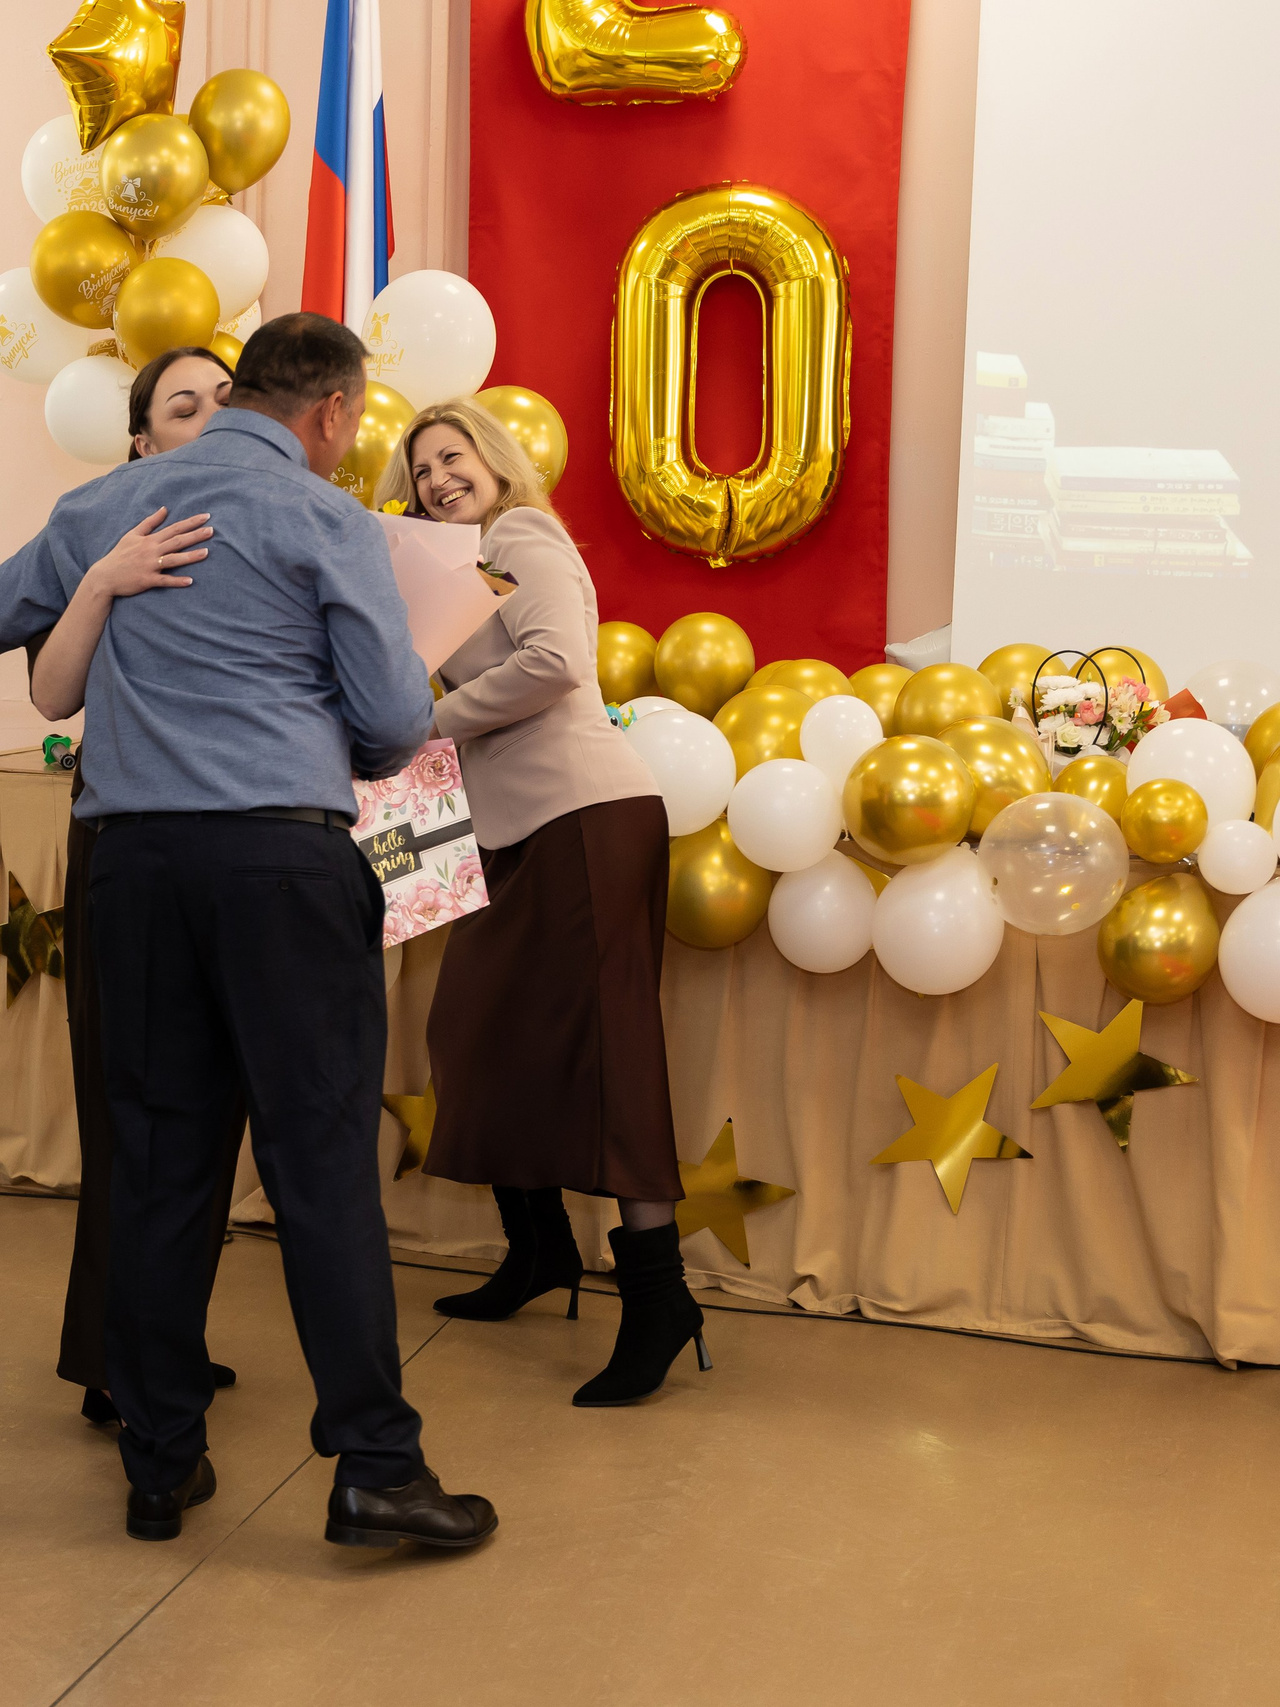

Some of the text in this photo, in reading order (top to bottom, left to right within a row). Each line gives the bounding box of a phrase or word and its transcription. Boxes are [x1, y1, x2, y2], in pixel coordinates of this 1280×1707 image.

[51, 159, 101, 184] Выпускн
[78, 251, 130, 299] Выпускной
[368, 829, 406, 857] hello
[372, 851, 415, 882] spring
